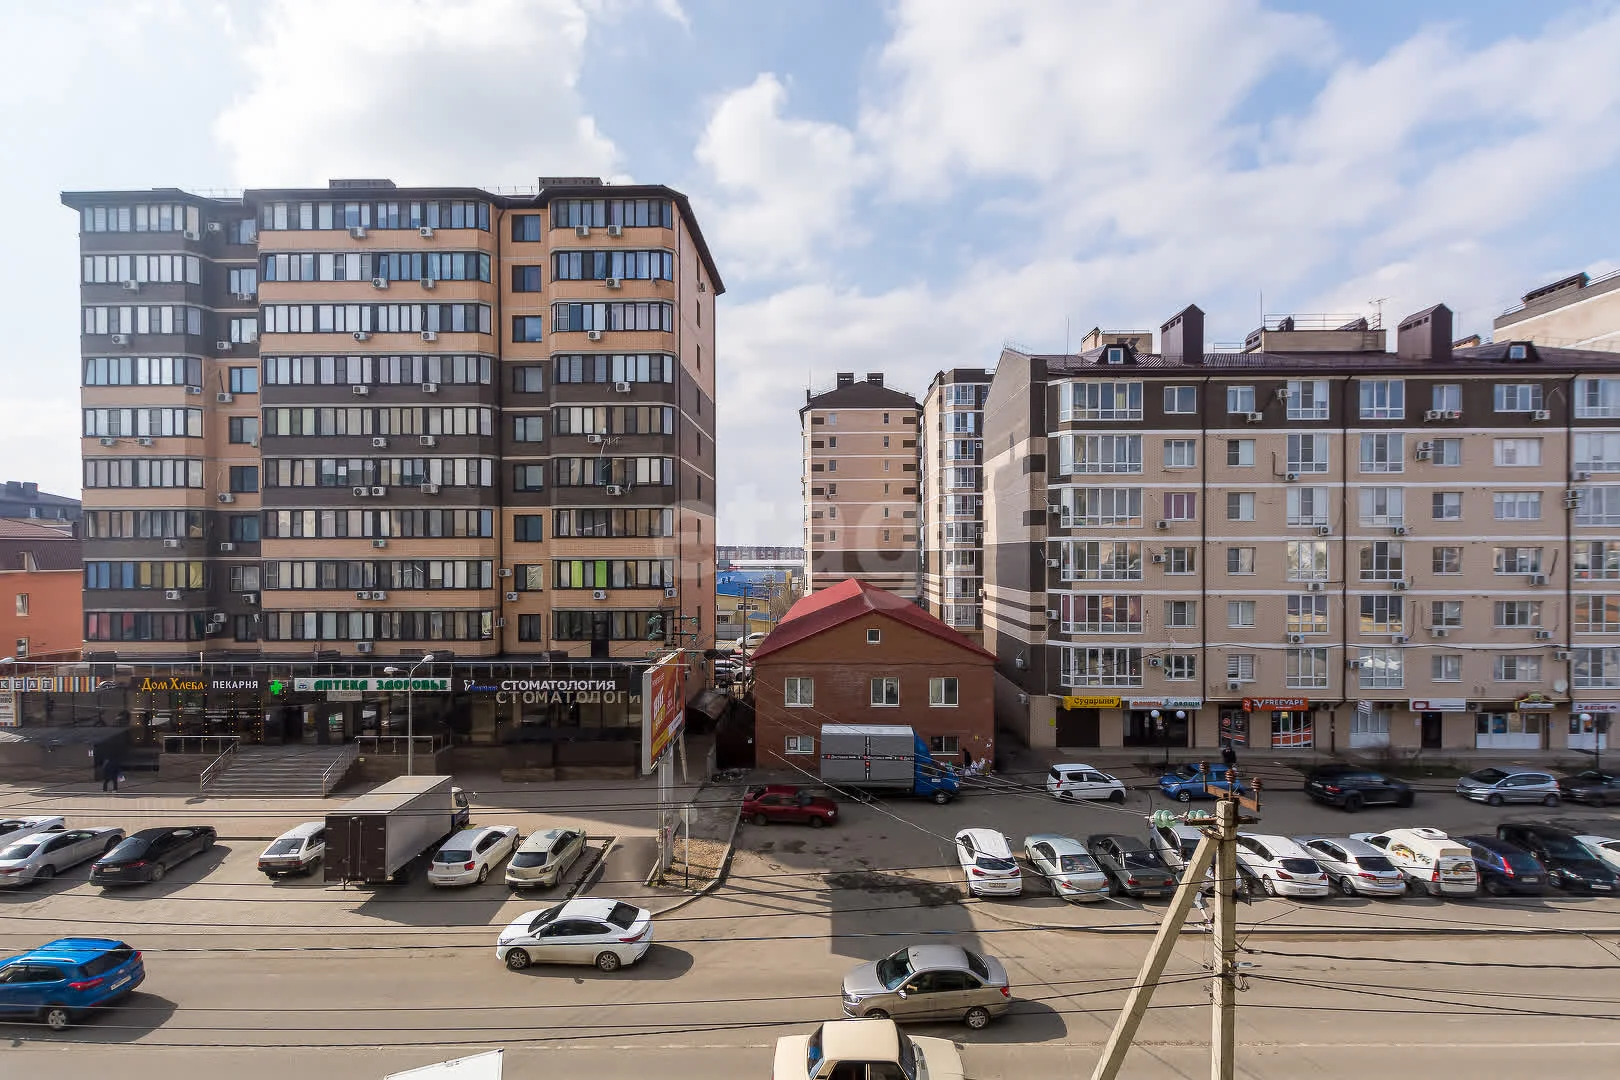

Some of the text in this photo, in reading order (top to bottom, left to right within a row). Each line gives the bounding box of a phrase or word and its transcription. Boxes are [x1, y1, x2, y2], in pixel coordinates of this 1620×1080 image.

[212, 681, 258, 689] ПЕКАРНЯ
[314, 680, 368, 690] АПТЕКА
[501, 680, 616, 690] СТОМАТОЛОГИЯ
[495, 691, 641, 703] СТОМАТОЛОГИ
[1074, 697, 1114, 705] Сударыня
